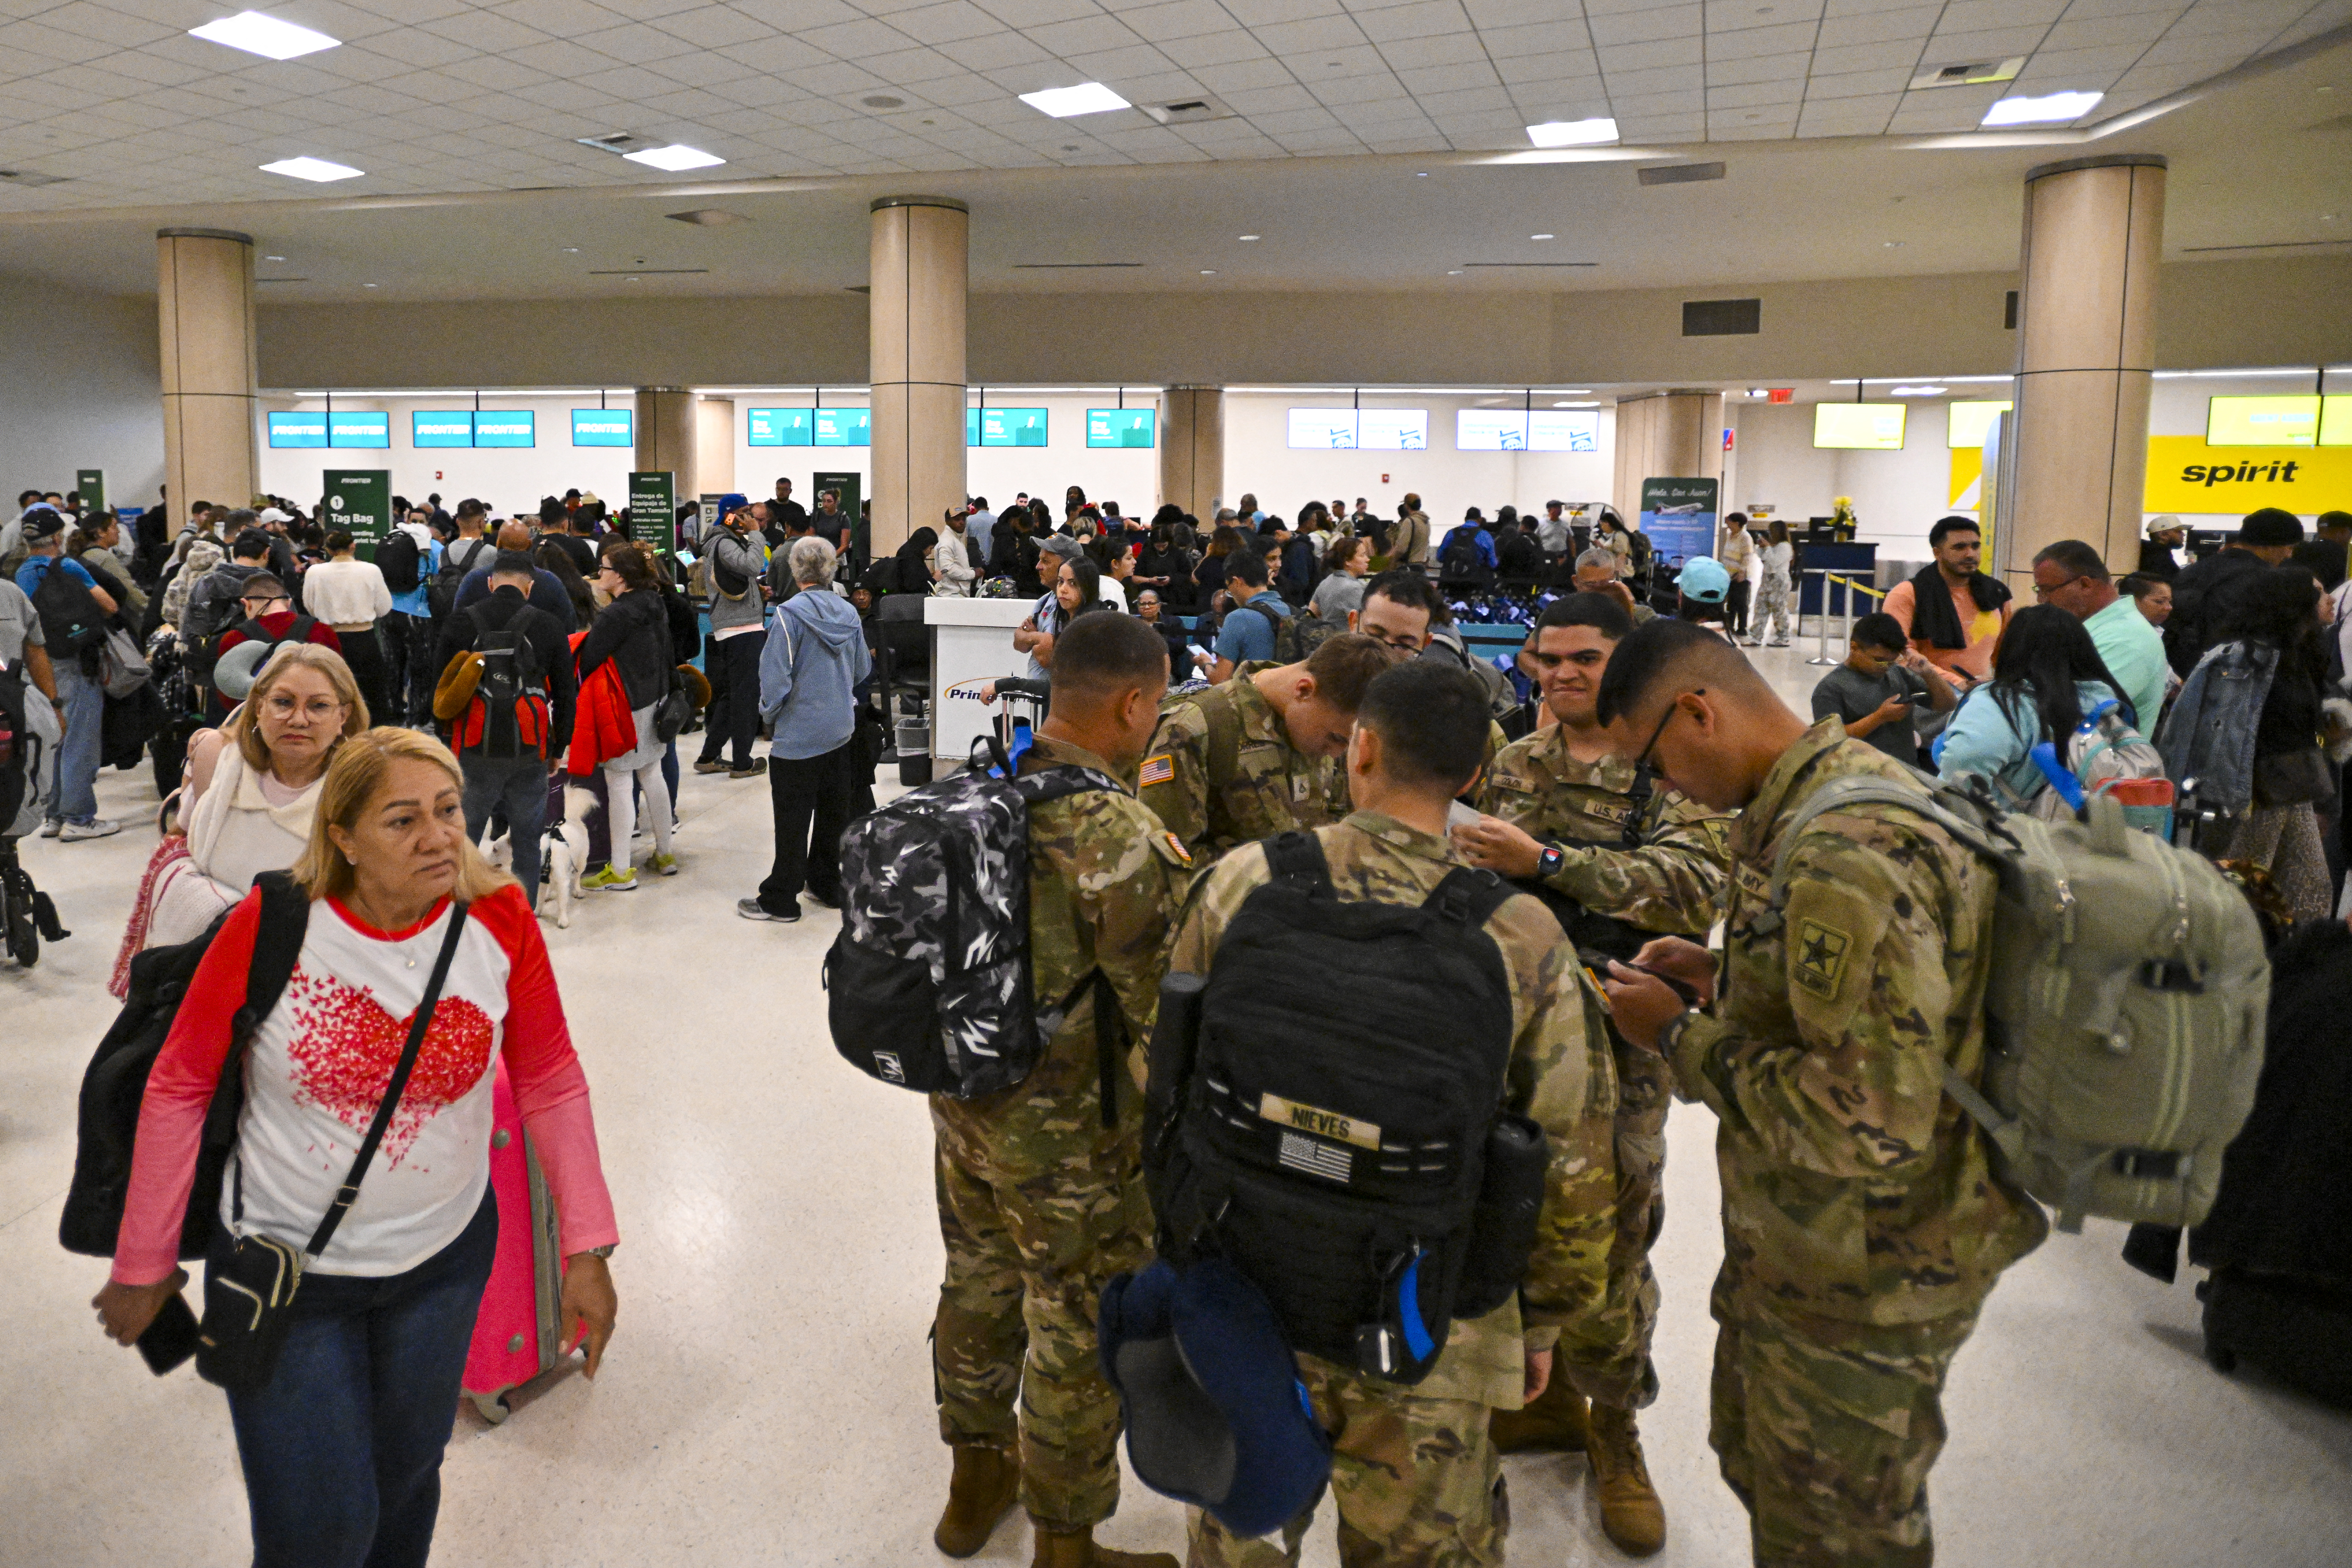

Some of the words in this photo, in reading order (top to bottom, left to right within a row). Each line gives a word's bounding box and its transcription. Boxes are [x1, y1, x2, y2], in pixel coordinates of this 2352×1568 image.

[272, 425, 325, 435] FRONTIER
[333, 425, 385, 435] FRONTIER
[417, 425, 470, 434] FRONTIER
[477, 424, 531, 434] FRONTIER
[575, 423, 628, 433] FRONTIER
[2181, 461, 2299, 487] spirit
[331, 513, 350, 525] Tag
[353, 514, 373, 525] Bag
[1292, 1106, 1351, 1138] NIEVES
